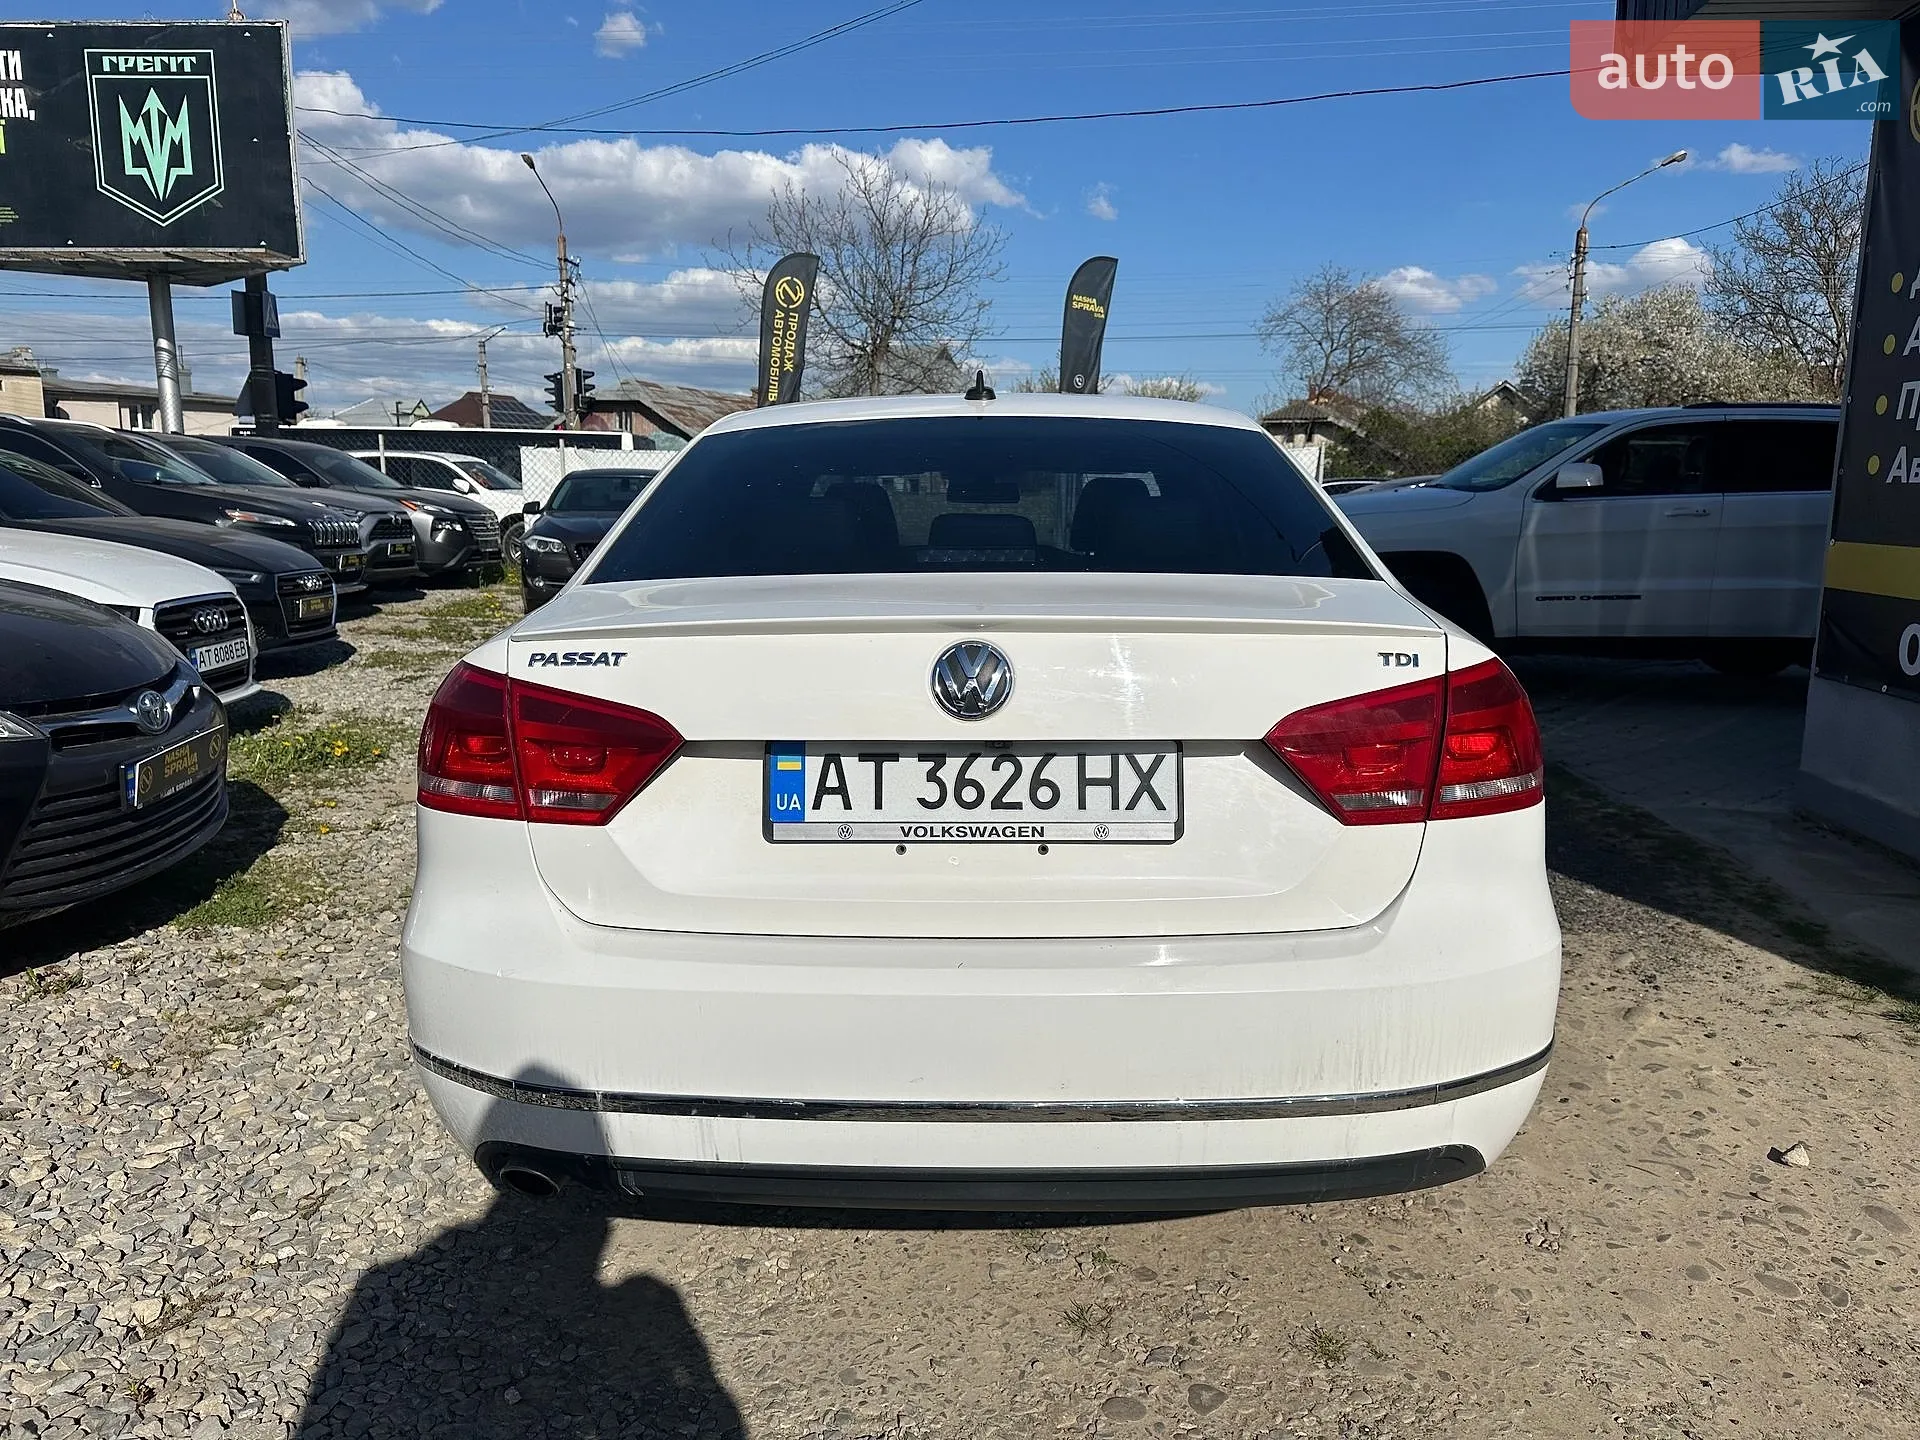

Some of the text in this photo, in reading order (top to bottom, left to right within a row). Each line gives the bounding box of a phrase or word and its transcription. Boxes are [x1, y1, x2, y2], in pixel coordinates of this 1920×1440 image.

[0, 87, 36, 120] КА,
[1072, 294, 1097, 306] NASHA
[1072, 301, 1104, 314] SPRAVA
[784, 312, 799, 372] ПРОДАЖ
[768, 309, 785, 402] АВТОМОБІЛІВ
[1896, 380, 1920, 431] П
[199, 641, 246, 667] AT 8088 EB
[528, 652, 628, 667] PASSAT
[1377, 652, 1419, 667] TDI
[811, 753, 1167, 811] AT 3626 HX
[776, 793, 801, 811] UA
[900, 825, 1045, 838] VOLKSWAGEN
